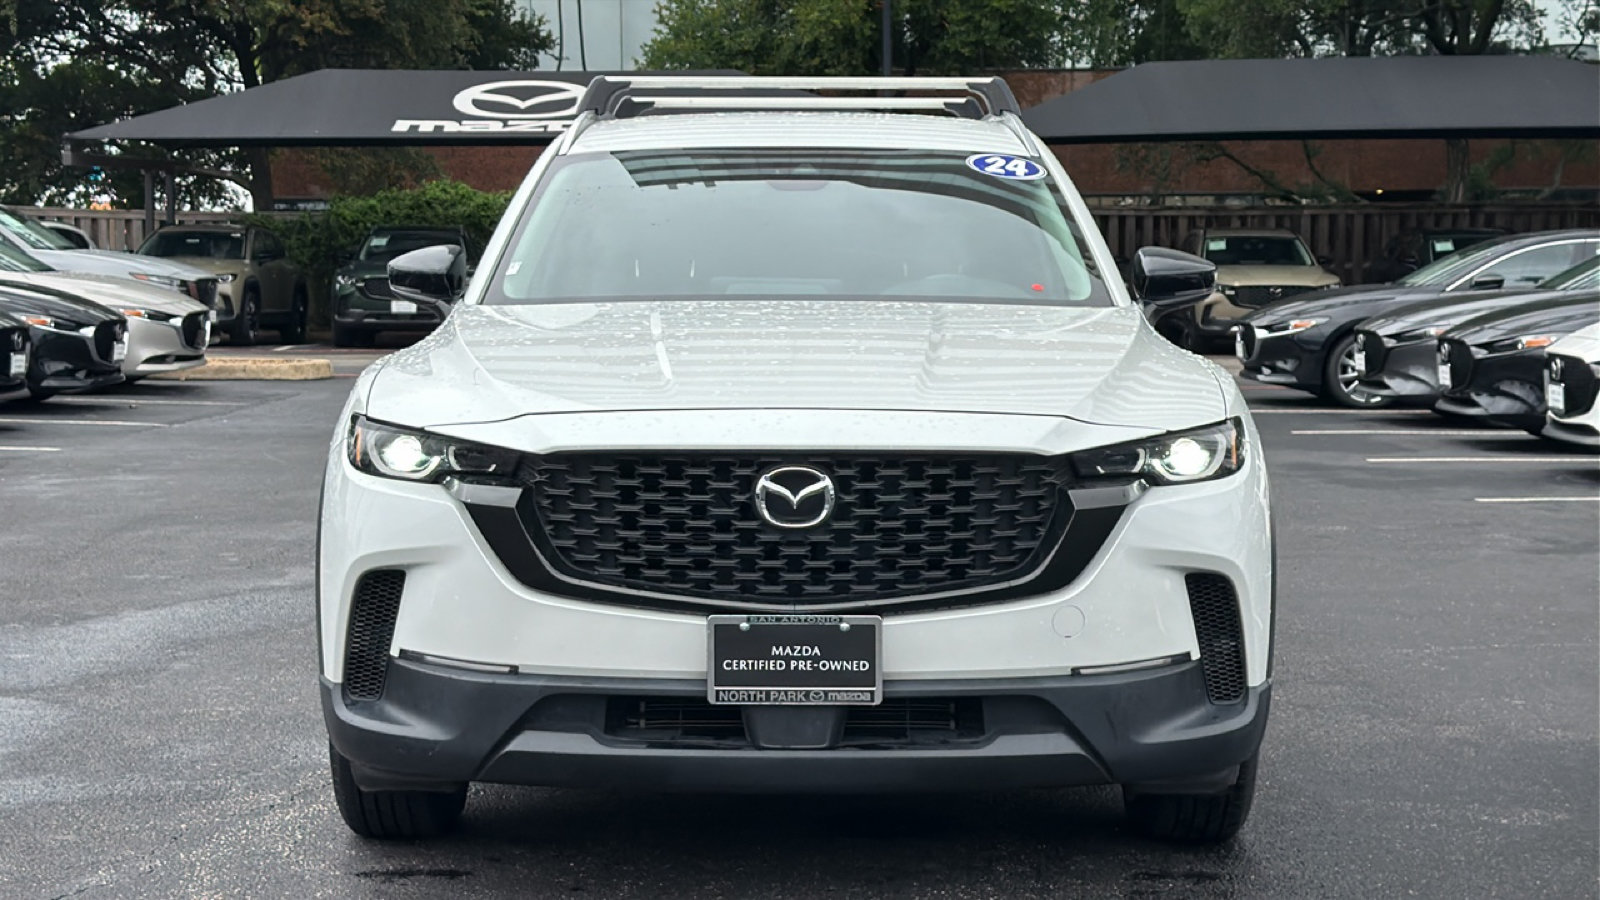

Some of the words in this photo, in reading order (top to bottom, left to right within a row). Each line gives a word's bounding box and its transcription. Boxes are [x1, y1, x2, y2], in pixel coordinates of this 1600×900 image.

[984, 157, 1029, 176] 24
[750, 616, 776, 624] SAN
[780, 616, 841, 624] ANTONIO
[771, 645, 821, 656] MAZDA
[722, 659, 786, 671] CERTIFIED
[790, 659, 870, 671] PRE-OWNED
[719, 690, 765, 702] NORTH
[770, 690, 806, 702] PARK
[828, 691, 871, 701] mazda
